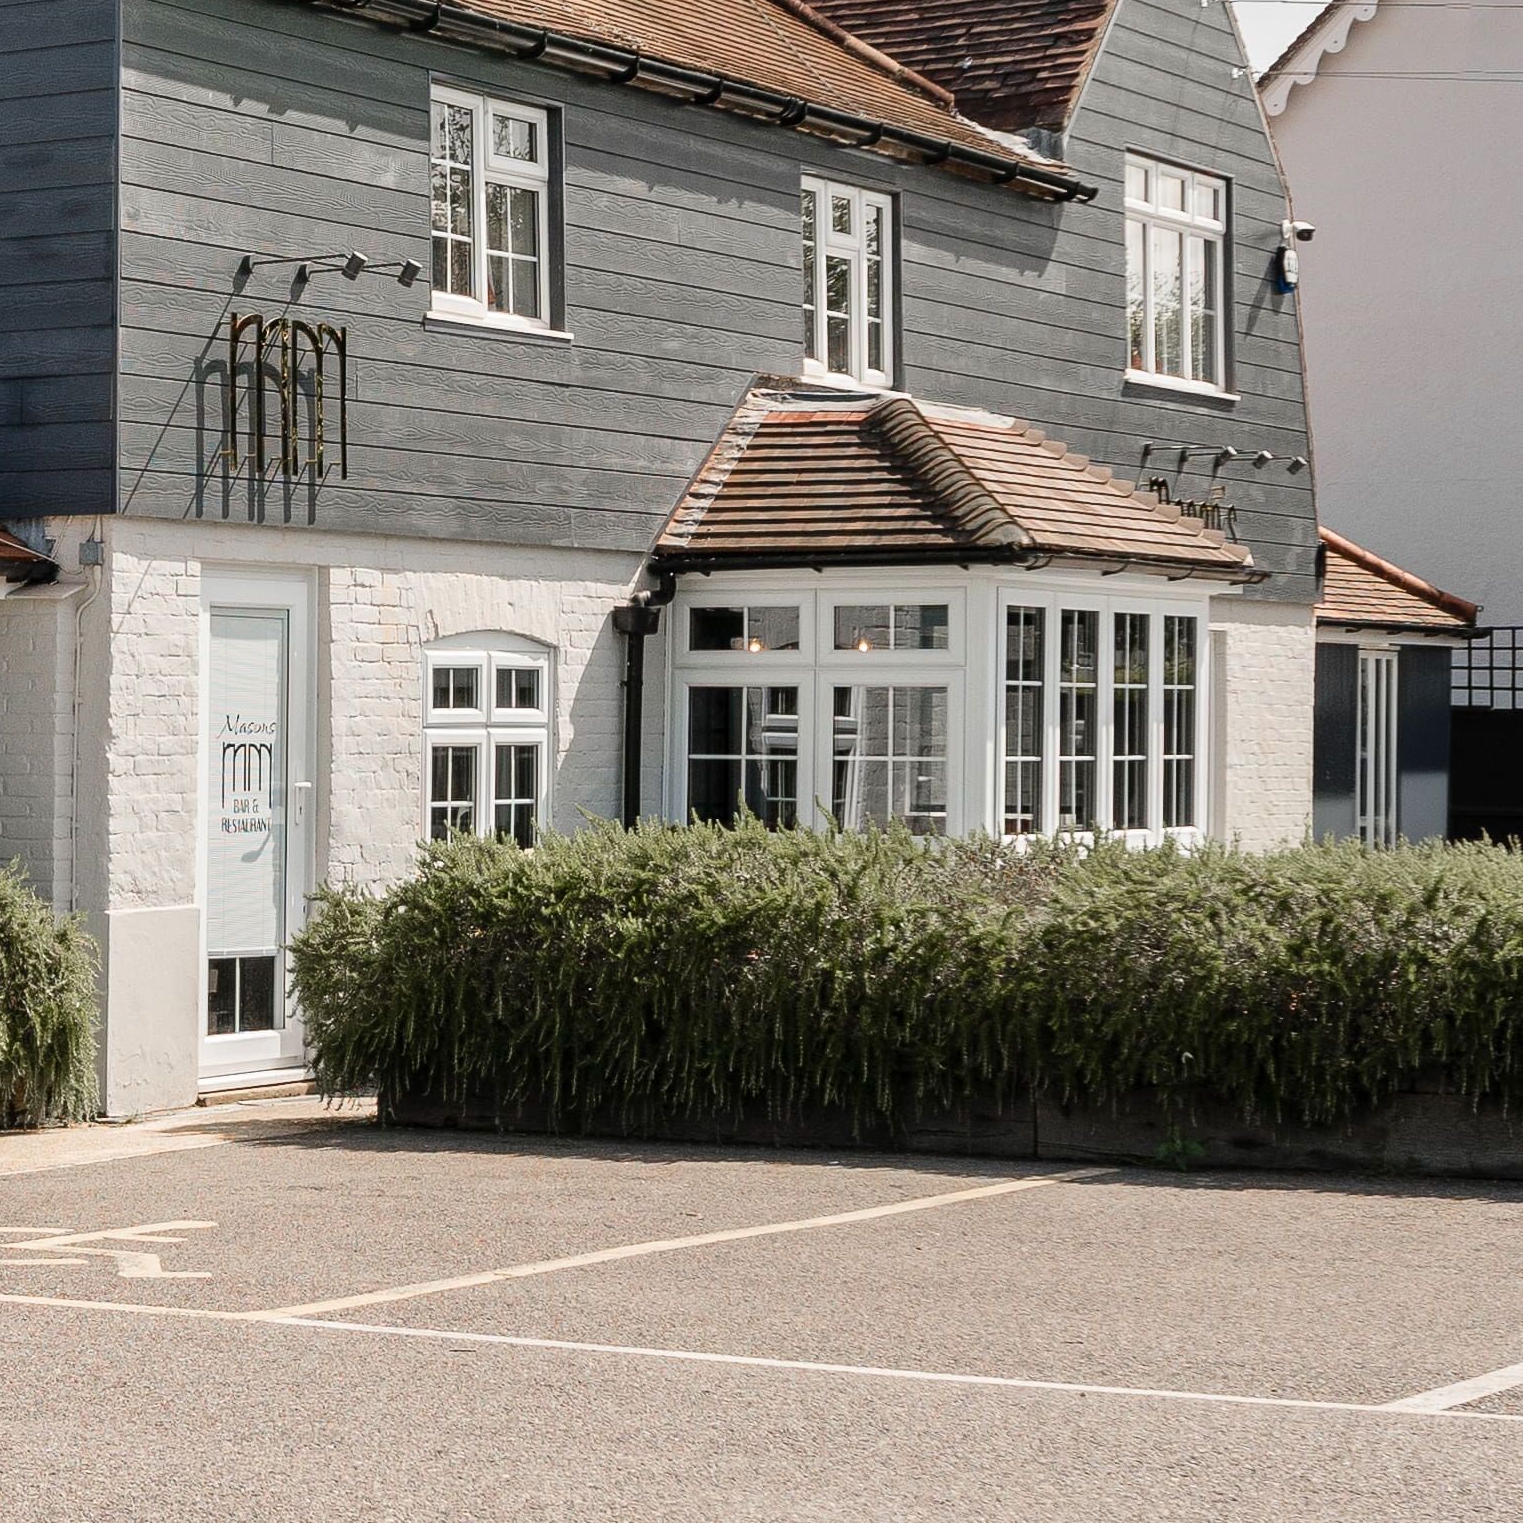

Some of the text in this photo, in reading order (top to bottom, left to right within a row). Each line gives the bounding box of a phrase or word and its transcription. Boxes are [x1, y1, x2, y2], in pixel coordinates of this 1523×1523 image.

[216, 714, 276, 739] Masons
[233, 798, 250, 814] BAR
[221, 817, 273, 834] RESTAURANT
